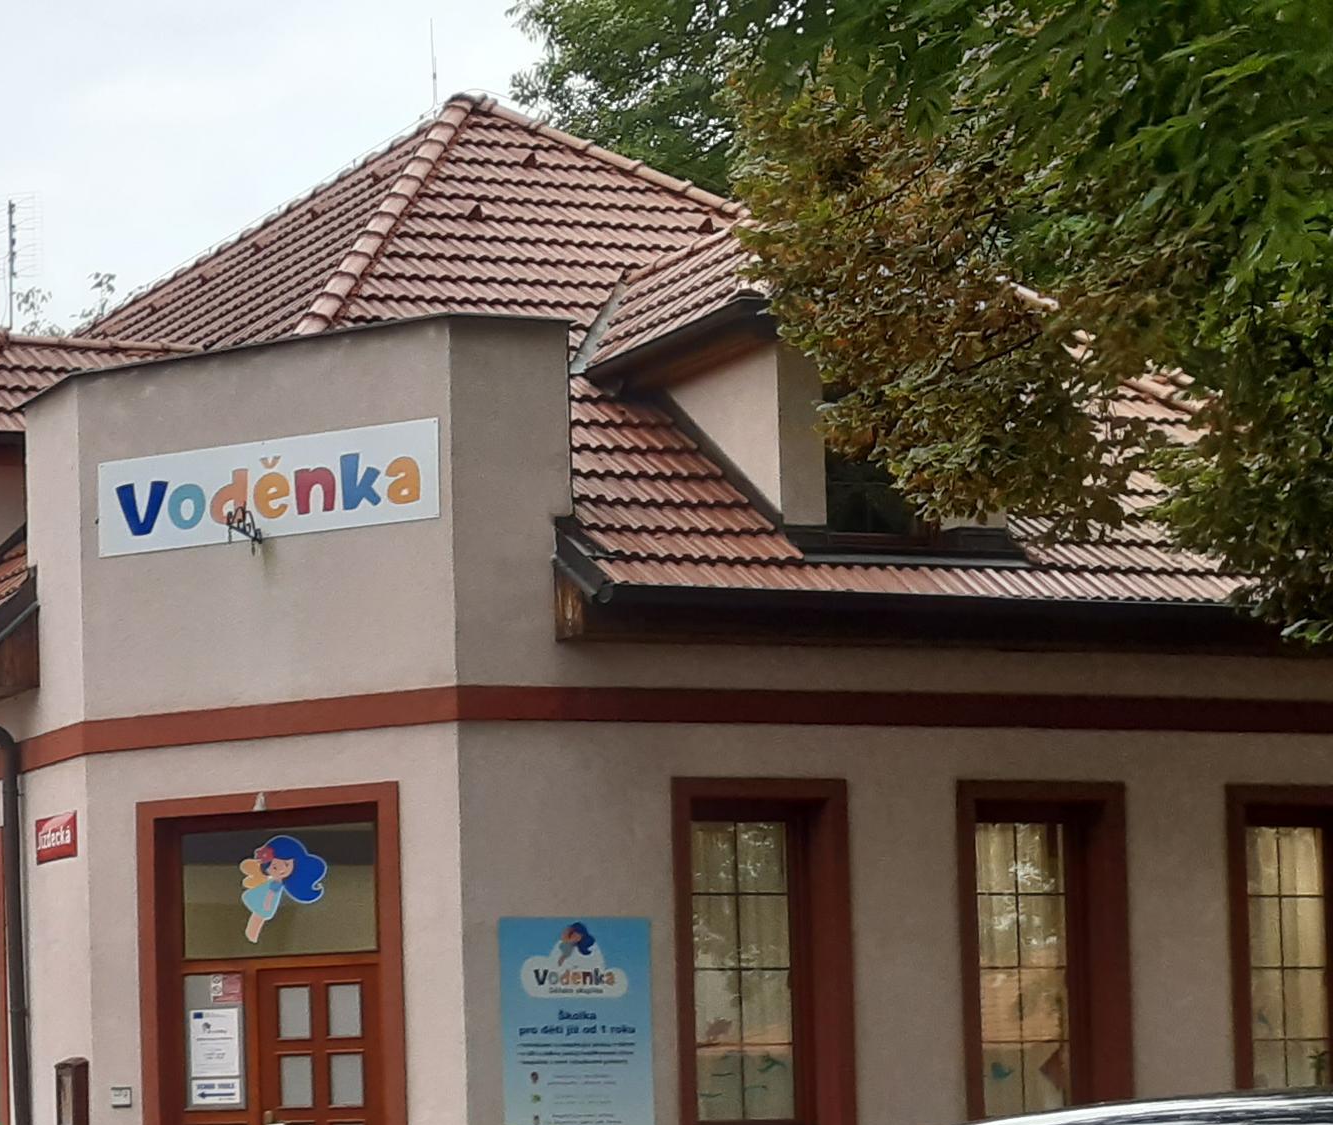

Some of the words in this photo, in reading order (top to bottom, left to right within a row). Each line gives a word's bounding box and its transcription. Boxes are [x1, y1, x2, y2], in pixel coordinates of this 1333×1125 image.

[115, 453, 422, 537] Voděnka
[557, 1009, 597, 1021] Školka
[518, 1026, 539, 1037] pro
[540, 1025, 564, 1034] děti
[582, 1024, 598, 1034] od
[600, 1025, 607, 1034] 1
[609, 1025, 637, 1034] roku
